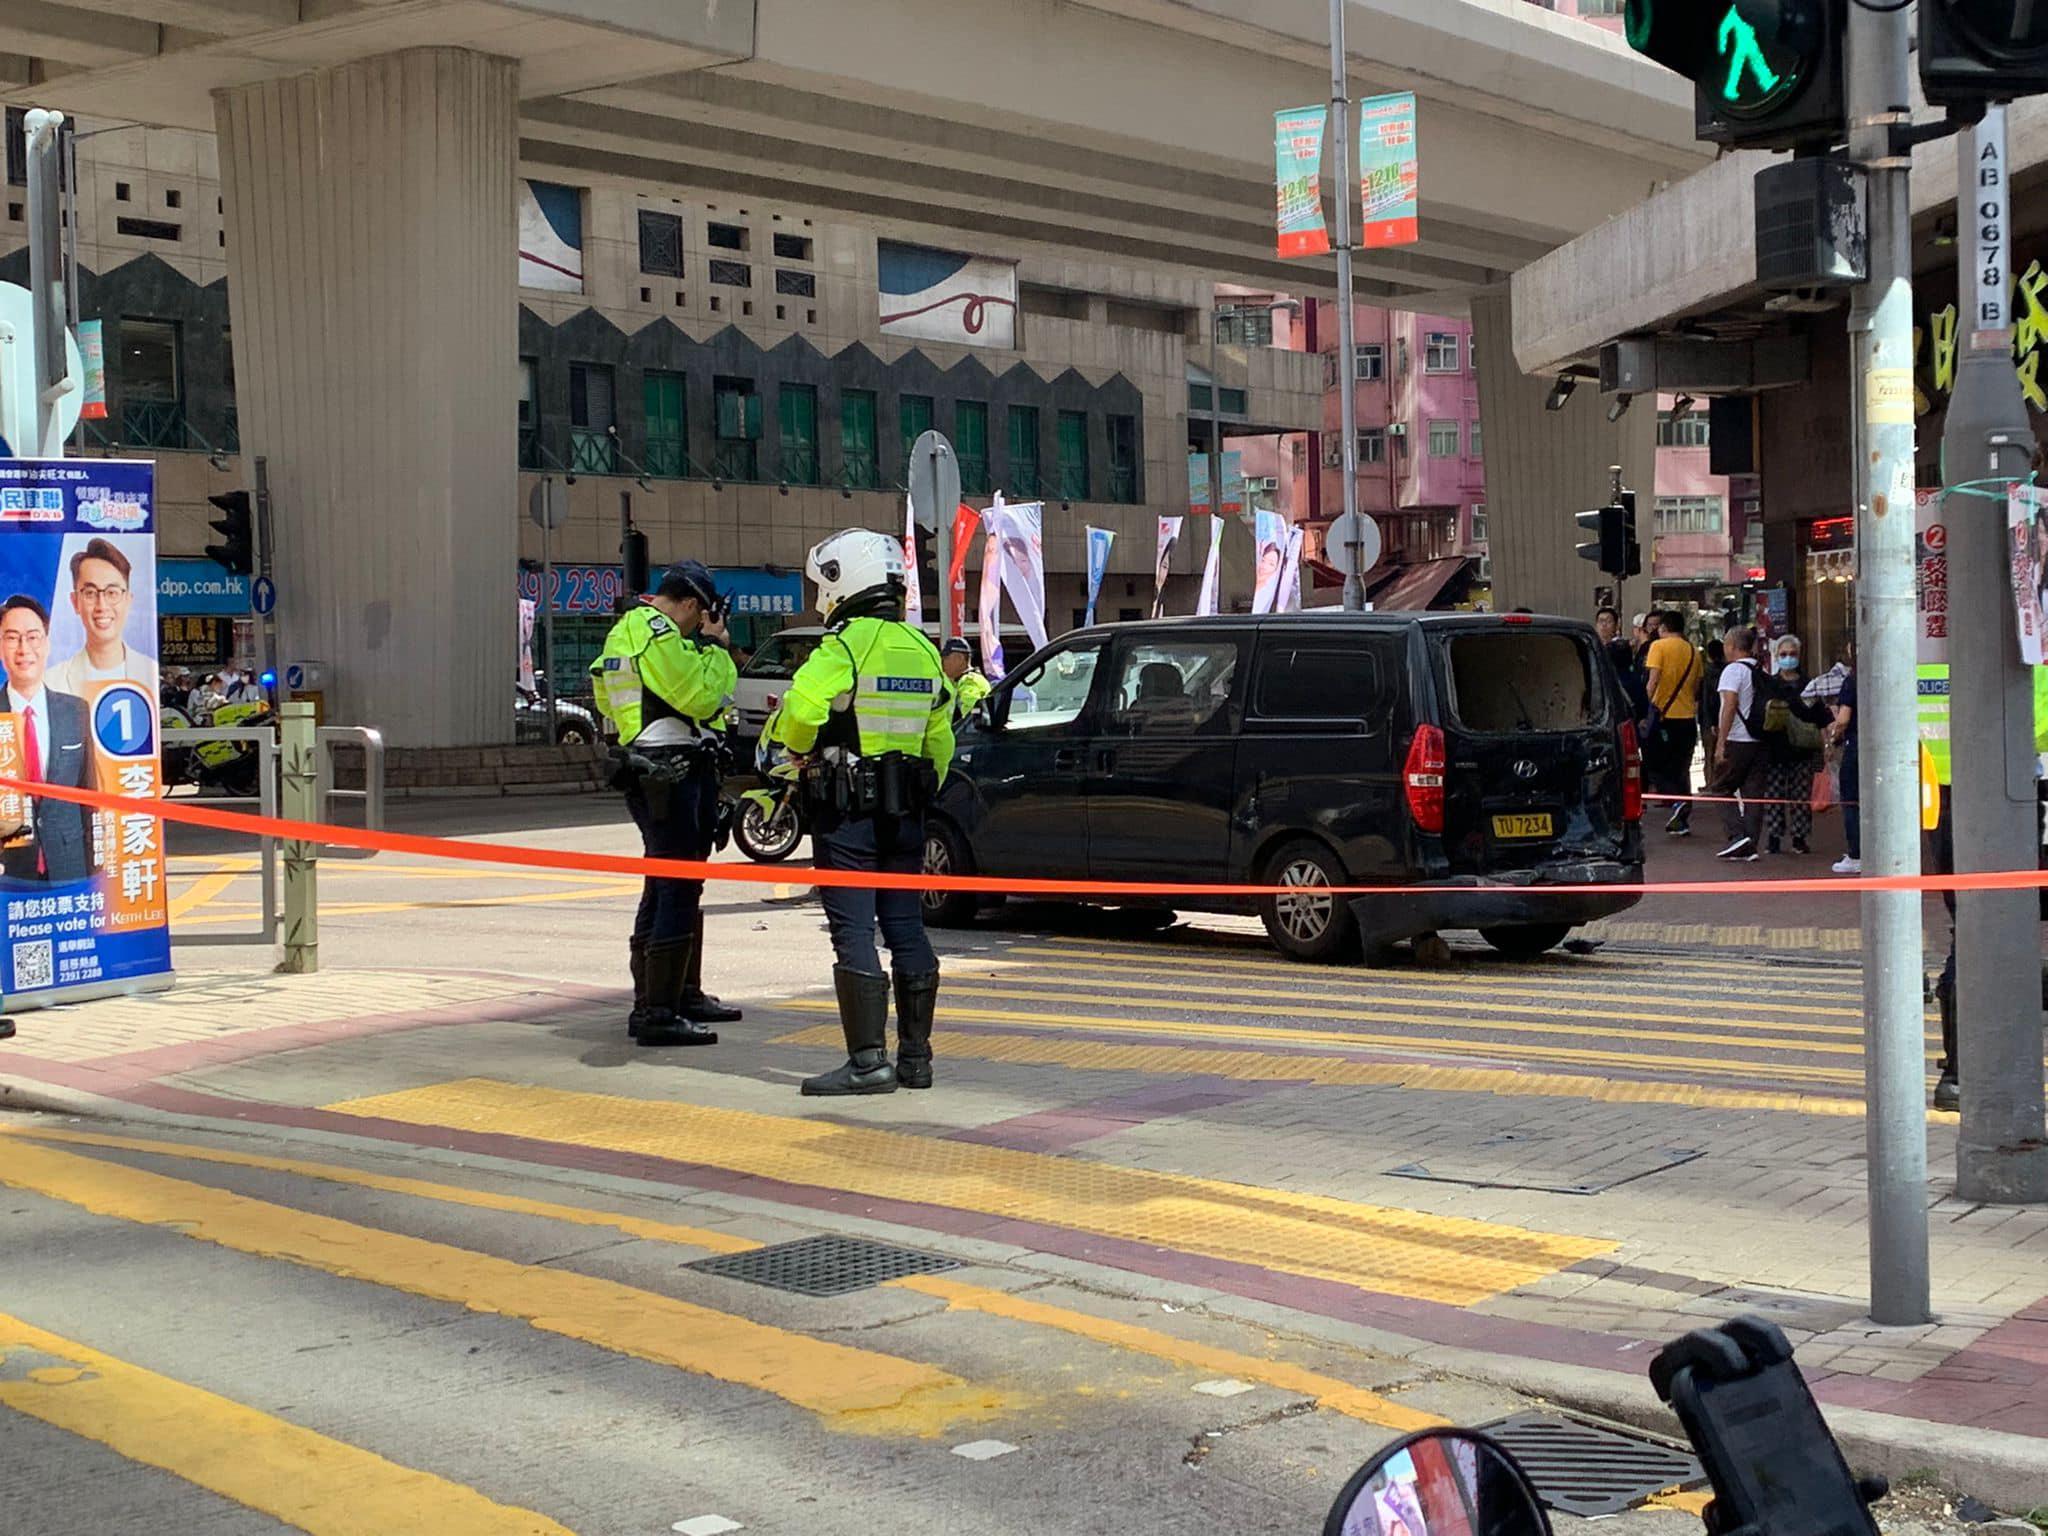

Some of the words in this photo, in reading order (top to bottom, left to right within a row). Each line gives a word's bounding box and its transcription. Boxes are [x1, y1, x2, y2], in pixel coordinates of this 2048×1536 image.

[4, 490, 60, 508] 民建聯
[1930, 528, 1944, 546] 2
[162, 643, 189, 655] 2392
[891, 679, 923, 690] POLICE
[1918, 681, 1950, 693] OLICE
[112, 699, 133, 741] 1
[118, 764, 158, 903] 李家軒
[1497, 816, 1513, 834] TU
[1516, 815, 1549, 833] 7234
[8, 892, 105, 920] 請您投票支持
[8, 923, 53, 938] Please
[56, 917, 87, 932] vote
[90, 914, 106, 928] for
